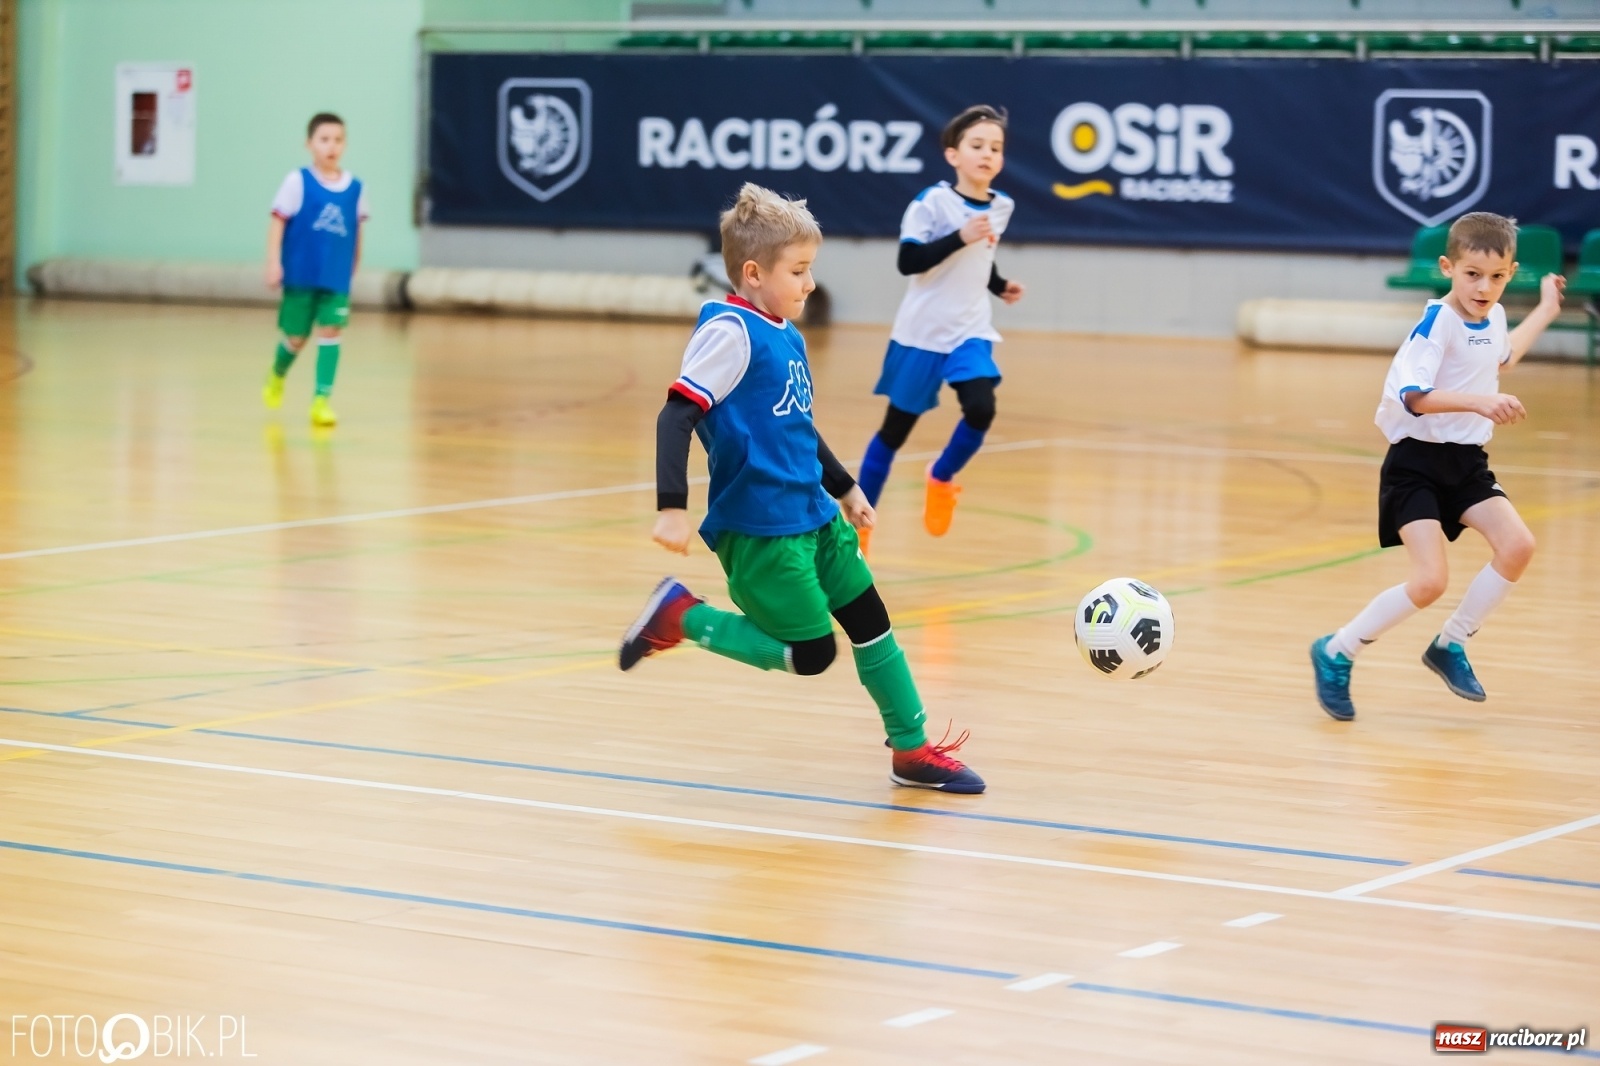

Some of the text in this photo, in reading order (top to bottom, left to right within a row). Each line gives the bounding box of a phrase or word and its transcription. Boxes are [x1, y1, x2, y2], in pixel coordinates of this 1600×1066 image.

[639, 102, 923, 173] RACIBÓRZ
[1554, 134, 1600, 190] R
[1120, 177, 1234, 204] RACIBÓRZ
